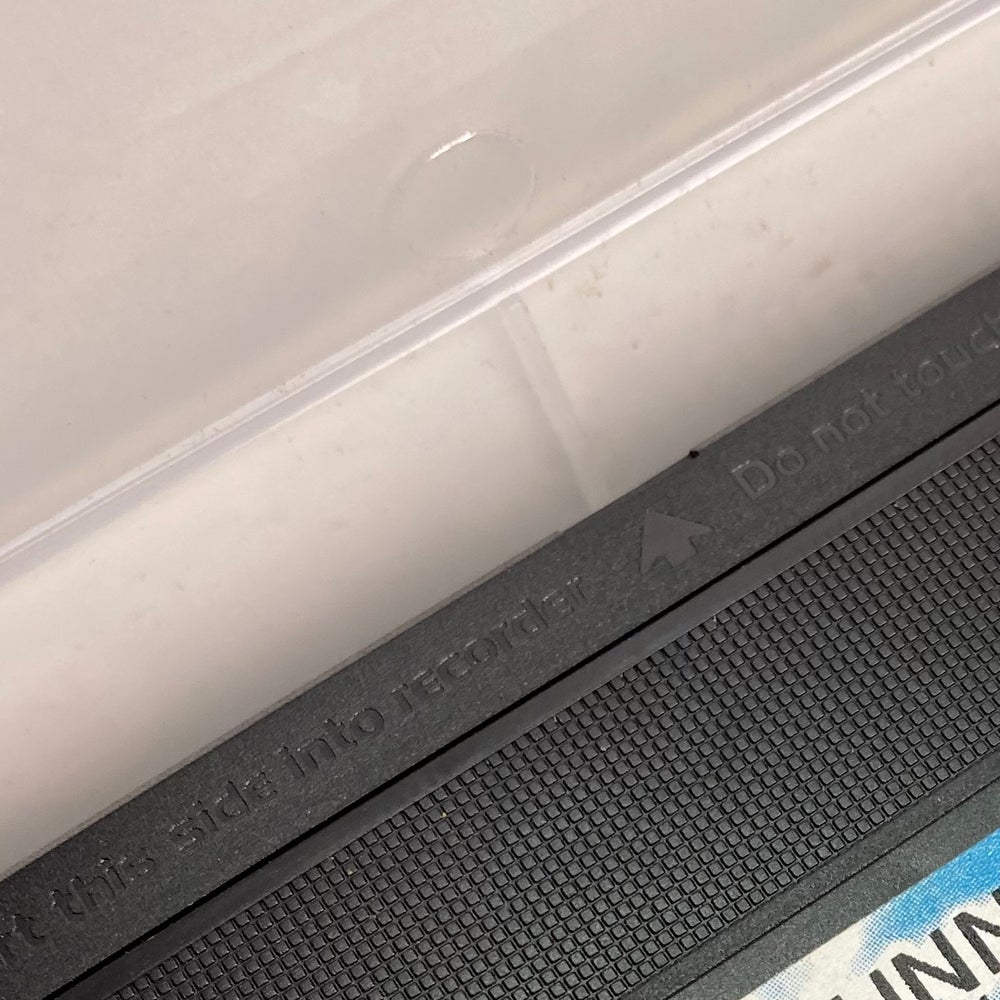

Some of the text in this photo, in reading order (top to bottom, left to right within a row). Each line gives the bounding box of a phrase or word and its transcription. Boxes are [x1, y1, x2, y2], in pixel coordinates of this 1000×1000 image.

[731, 435, 806, 501] Do
[805, 383, 892, 455] not
[164, 764, 279, 853] side
[278, 695, 388, 780] into
[387, 572, 593, 714] recorder
